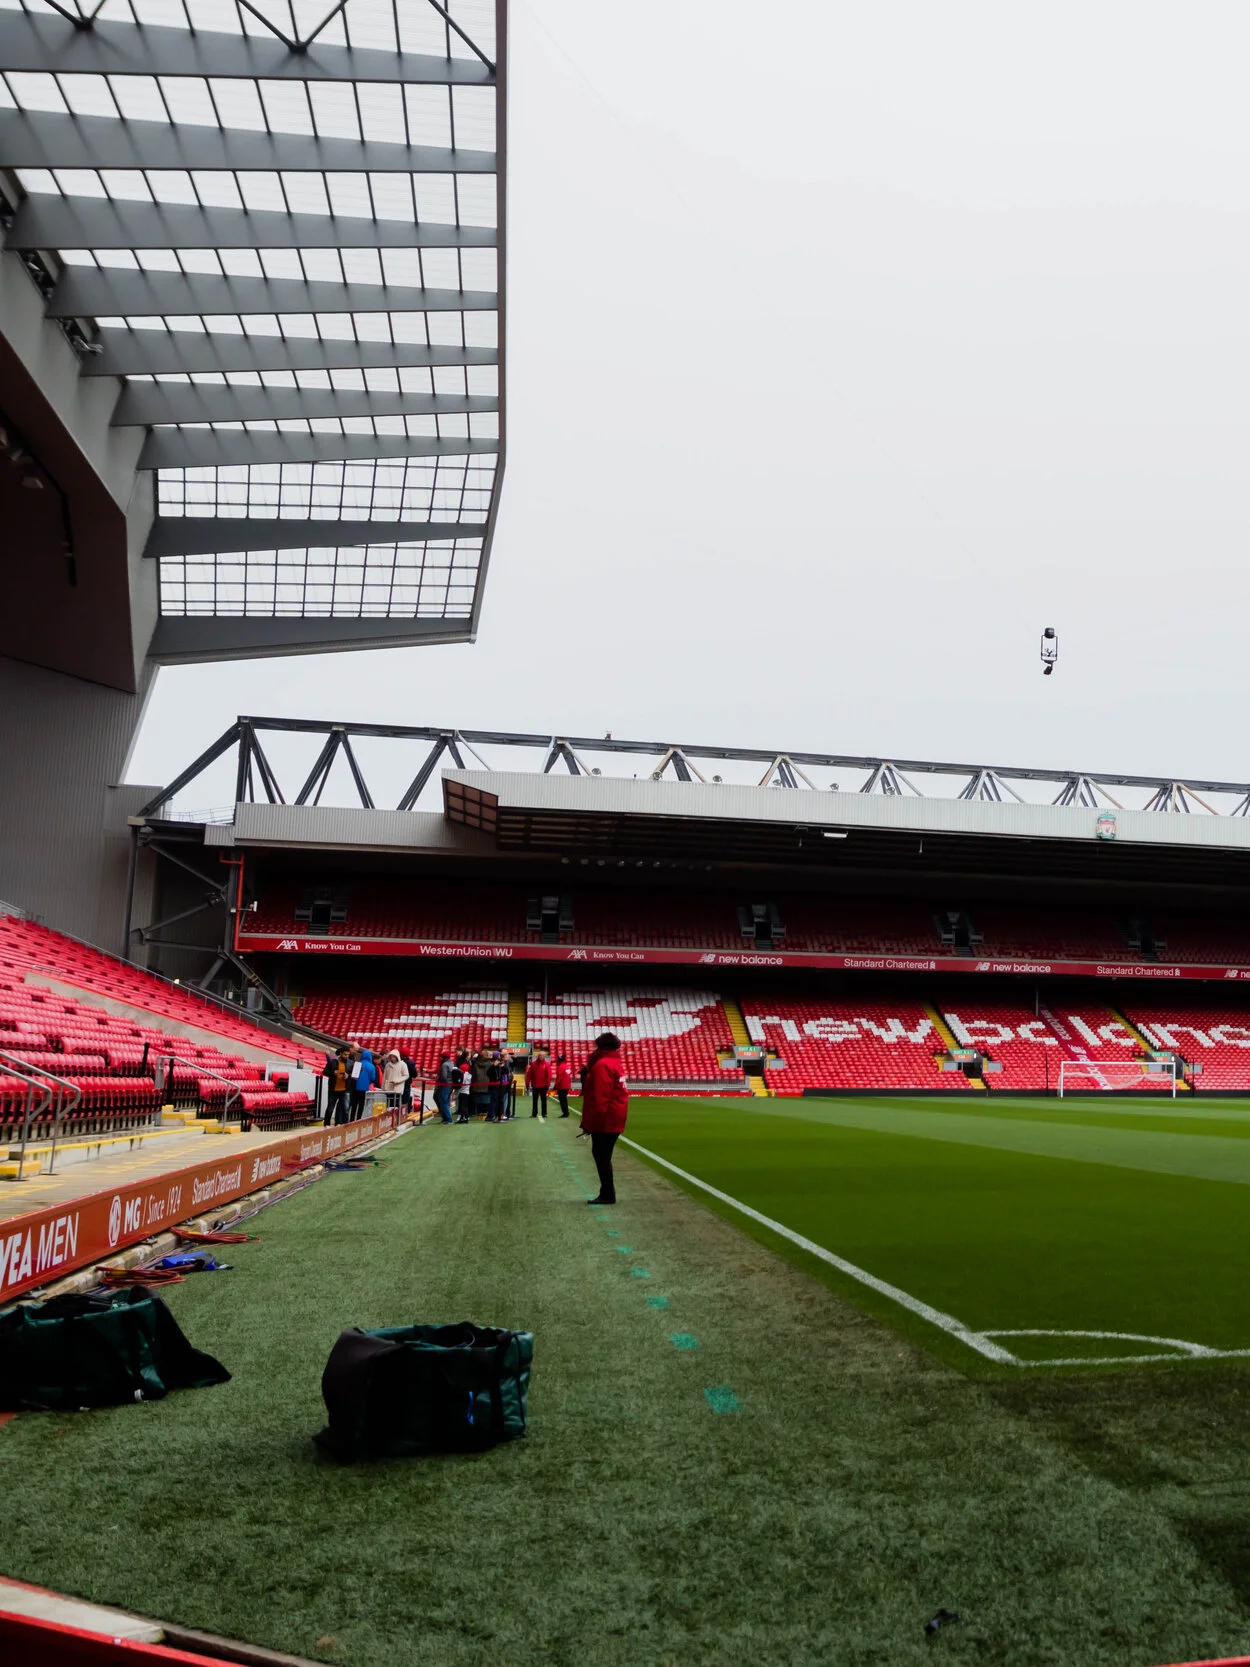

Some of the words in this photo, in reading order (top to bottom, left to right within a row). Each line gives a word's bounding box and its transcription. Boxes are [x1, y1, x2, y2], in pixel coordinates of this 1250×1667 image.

[276, 939, 299, 950] AXA
[304, 942, 327, 950] Know
[329, 943, 344, 951] You
[419, 945, 492, 957] WesternUnion
[567, 949, 588, 960] AXA
[593, 951, 614, 959] Know
[630, 952, 645, 960] Can
[718, 955, 739, 964] new
[741, 955, 783, 965] balance
[844, 958, 884, 968] Standard
[885, 959, 929, 969] Chartered
[992, 964, 1012, 972] new
[1013, 963, 1051, 973] balance
[1096, 966, 1133, 975] Standard
[1134, 967, 1174, 976] Chartered
[746, 1014, 933, 1044] new
[192, 1171, 216, 1206] Standard
[215, 1165, 239, 1196] Chartered
[124, 1196, 142, 1235] MG
[147, 1194, 165, 1225] Since
[166, 1184, 183, 1217] 1924
[36, 1211, 80, 1274] MEN
